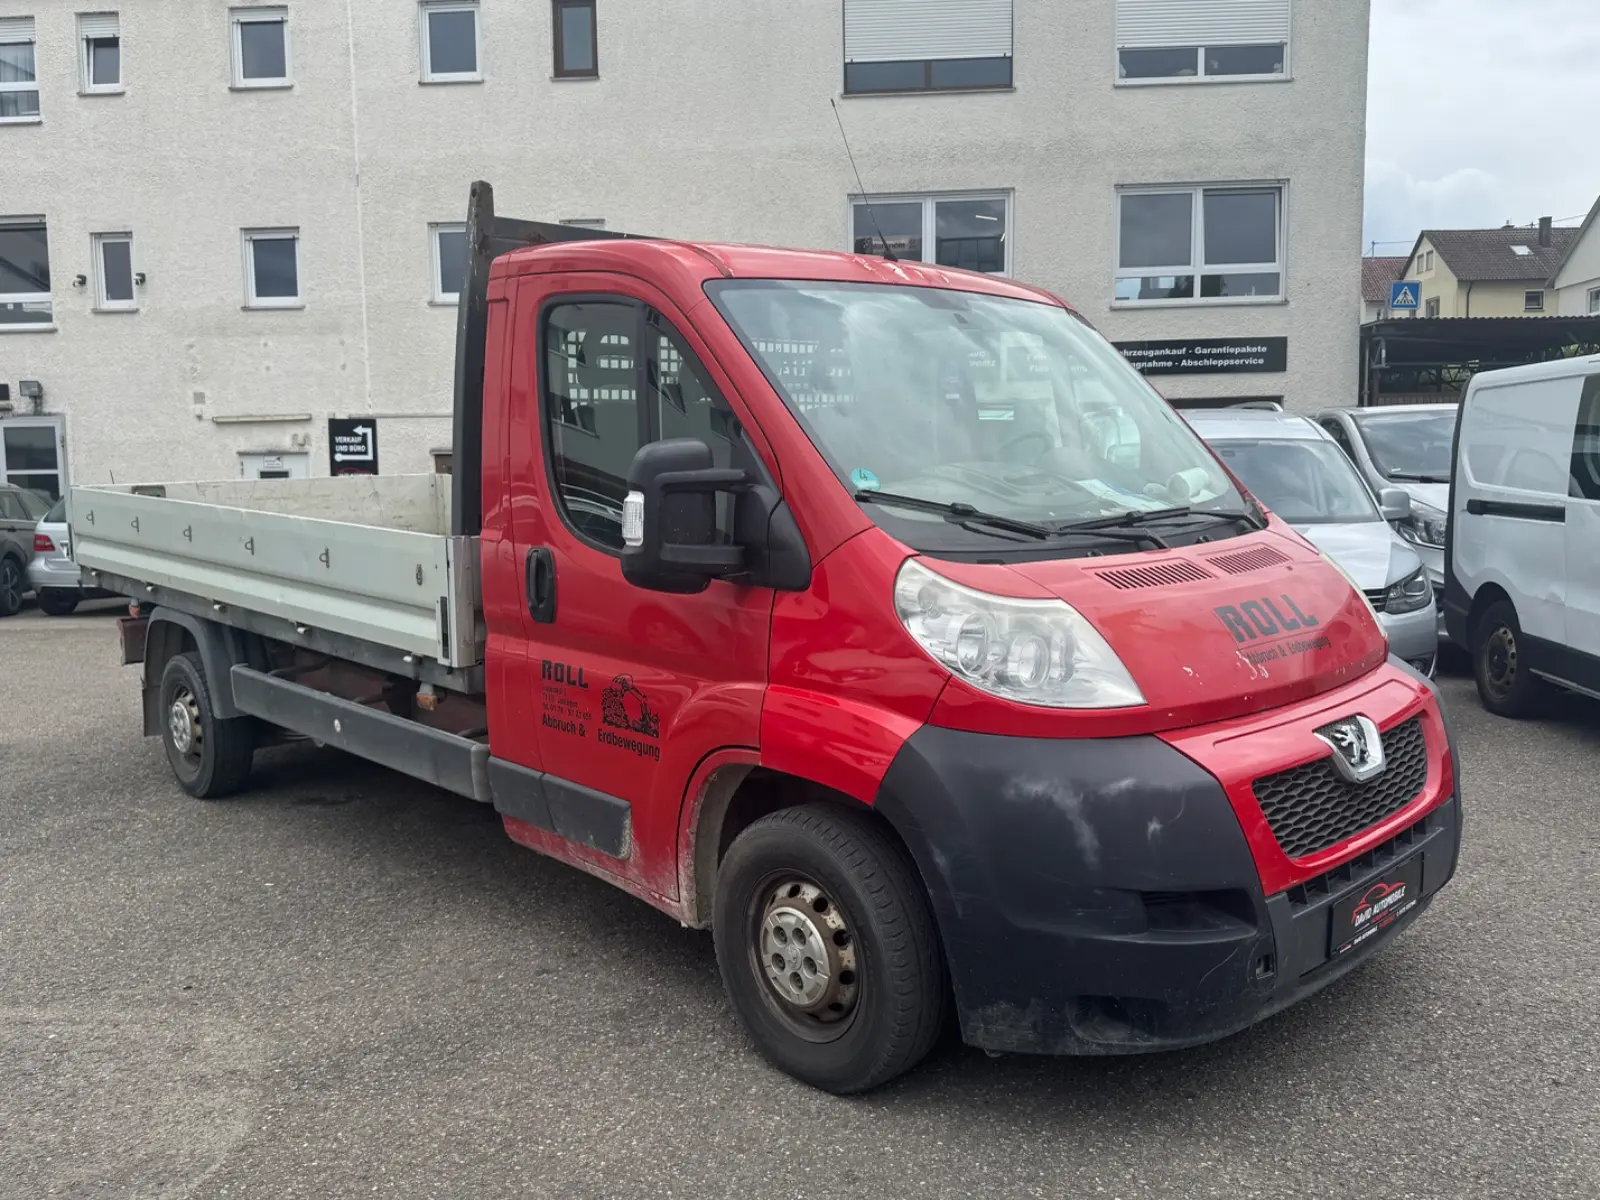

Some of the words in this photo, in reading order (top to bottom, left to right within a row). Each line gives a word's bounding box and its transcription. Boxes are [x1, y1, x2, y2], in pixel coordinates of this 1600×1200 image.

[1180, 356, 1265, 368] Abschleppservice
[1194, 345, 1267, 357] Garantiepakete
[349, 444, 366, 452] BÜRO
[1213, 594, 1319, 643] ROLL
[541, 659, 589, 689] ROLL
[542, 713, 577, 735] Abbruch
[578, 723, 586, 738] &
[597, 727, 661, 762] Erdbewegung
[1355, 907, 1372, 927] DAVID
[1373, 886, 1406, 915] AUTOMOBILE
